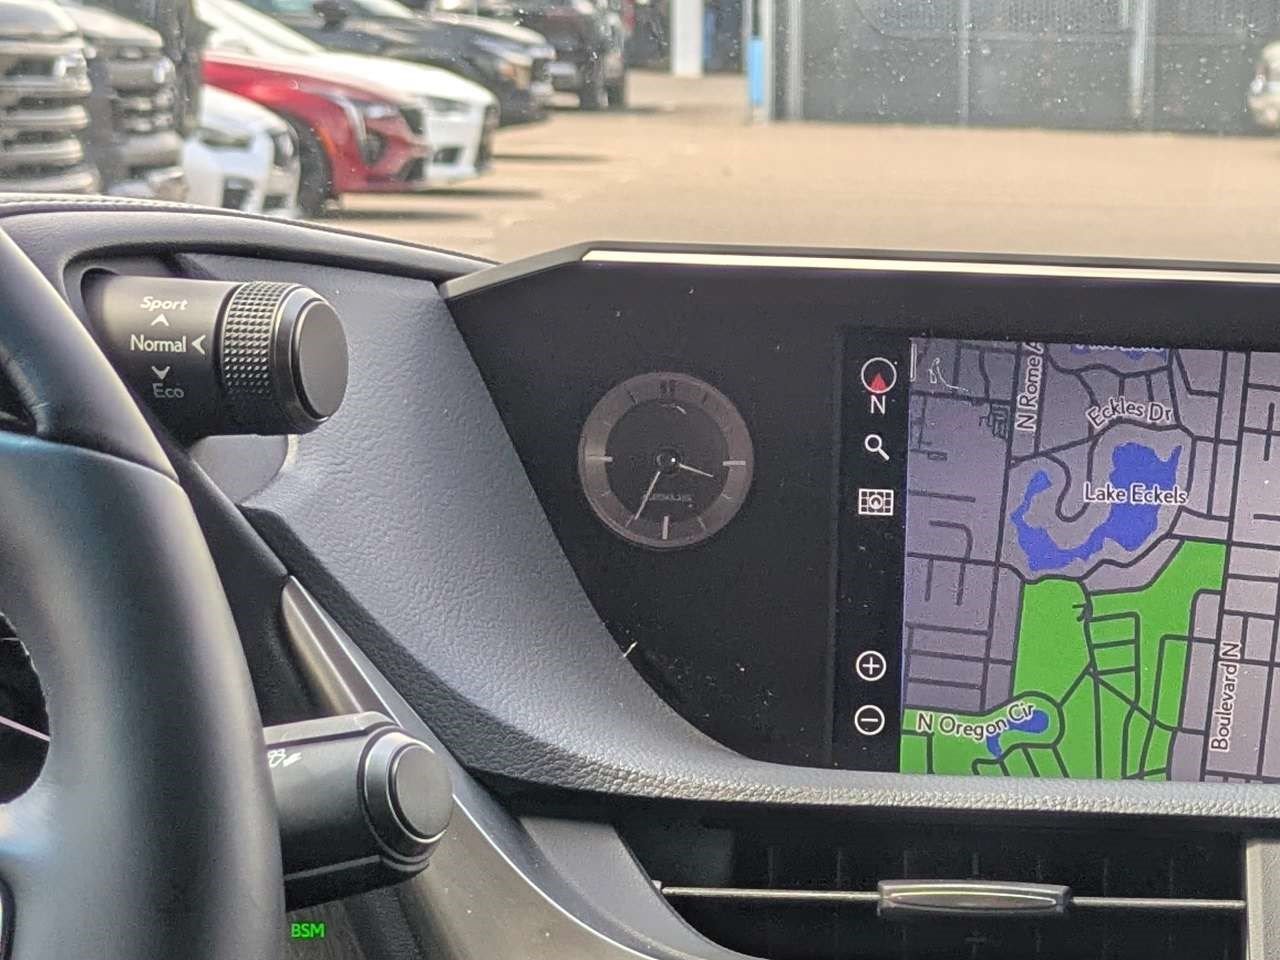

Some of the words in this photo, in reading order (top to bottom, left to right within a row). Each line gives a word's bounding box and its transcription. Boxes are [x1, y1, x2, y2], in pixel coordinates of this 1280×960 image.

[140, 296, 188, 311] Sport
[130, 334, 186, 352] Normal
[152, 383, 184, 398] Eco
[1020, 356, 1042, 408] Rome
[870, 395, 885, 414] N
[1087, 397, 1143, 427] Eckles
[1149, 403, 1172, 421] Dr
[1017, 414, 1034, 429] N
[1085, 482, 1126, 500] Lake
[1132, 484, 1186, 504] Eckels
[1223, 643, 1240, 658] N
[1212, 662, 1240, 750] Boulevard
[918, 714, 933, 731] N
[939, 716, 1008, 740] Oregon
[1008, 703, 1034, 722] Cir
[290, 923, 326, 939] BSM
